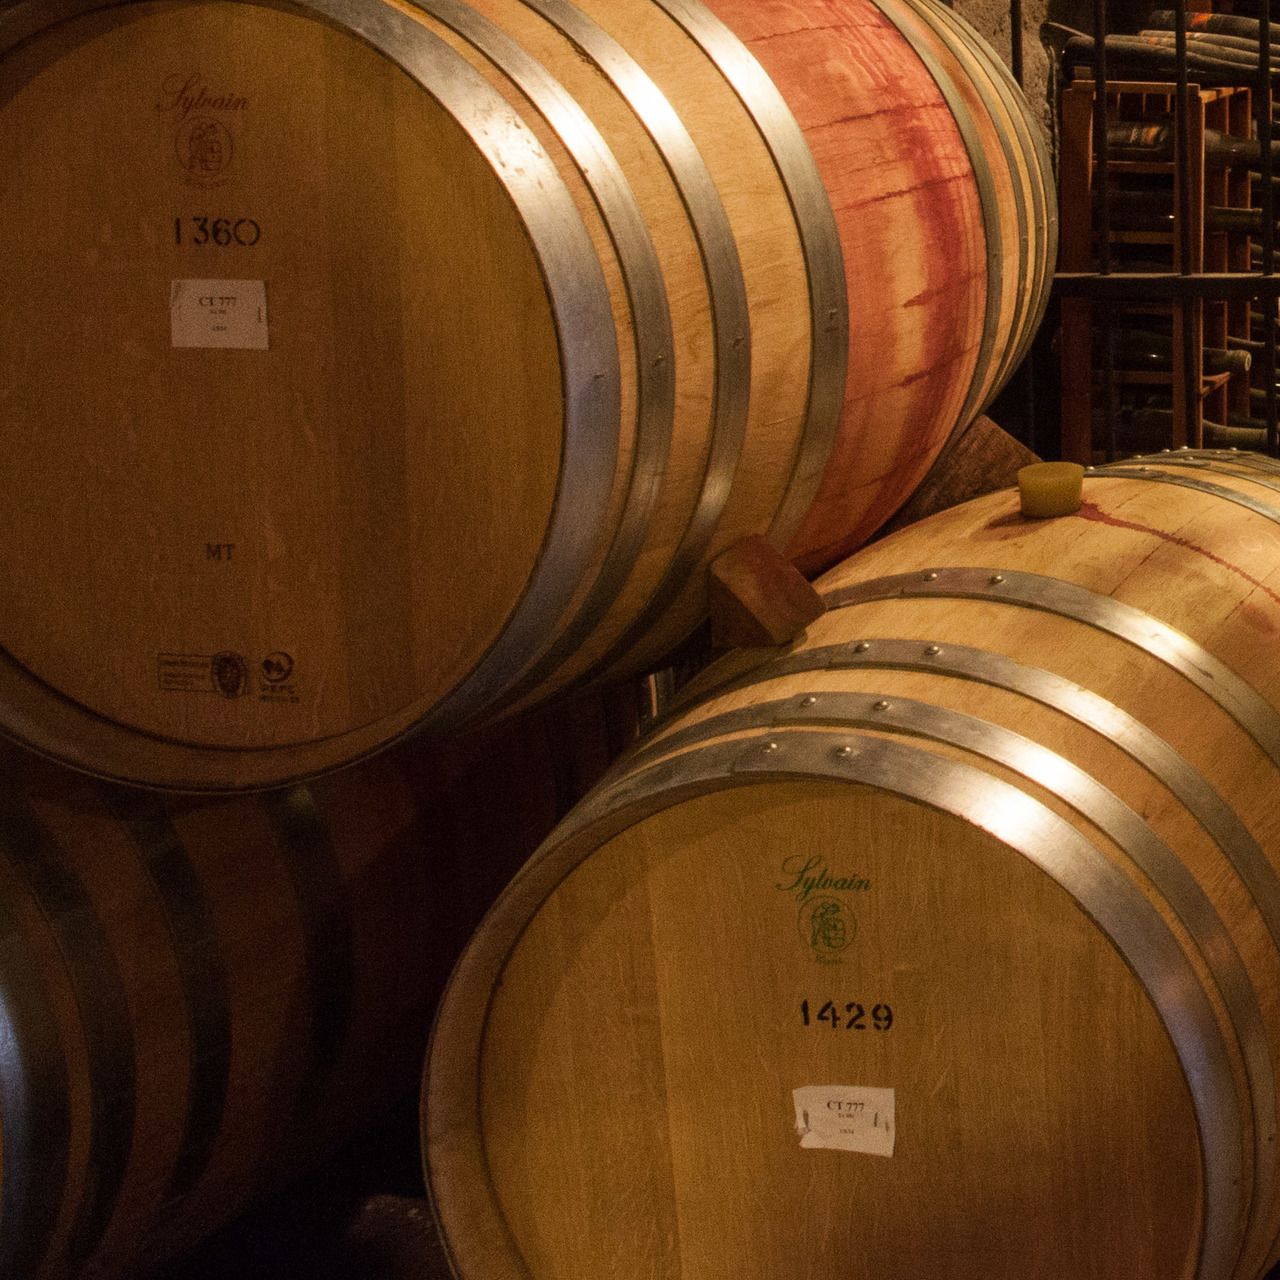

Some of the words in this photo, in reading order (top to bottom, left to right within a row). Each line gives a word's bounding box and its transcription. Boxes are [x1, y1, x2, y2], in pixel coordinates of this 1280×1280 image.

[155, 72, 249, 119] Sylvain
[175, 216, 260, 246] 1360
[205, 543, 236, 561] MT
[775, 855, 872, 903] Sylvain
[801, 999, 894, 1031] 1429
[827, 1100, 843, 1111] CT
[846, 1102, 865, 1113] 777
